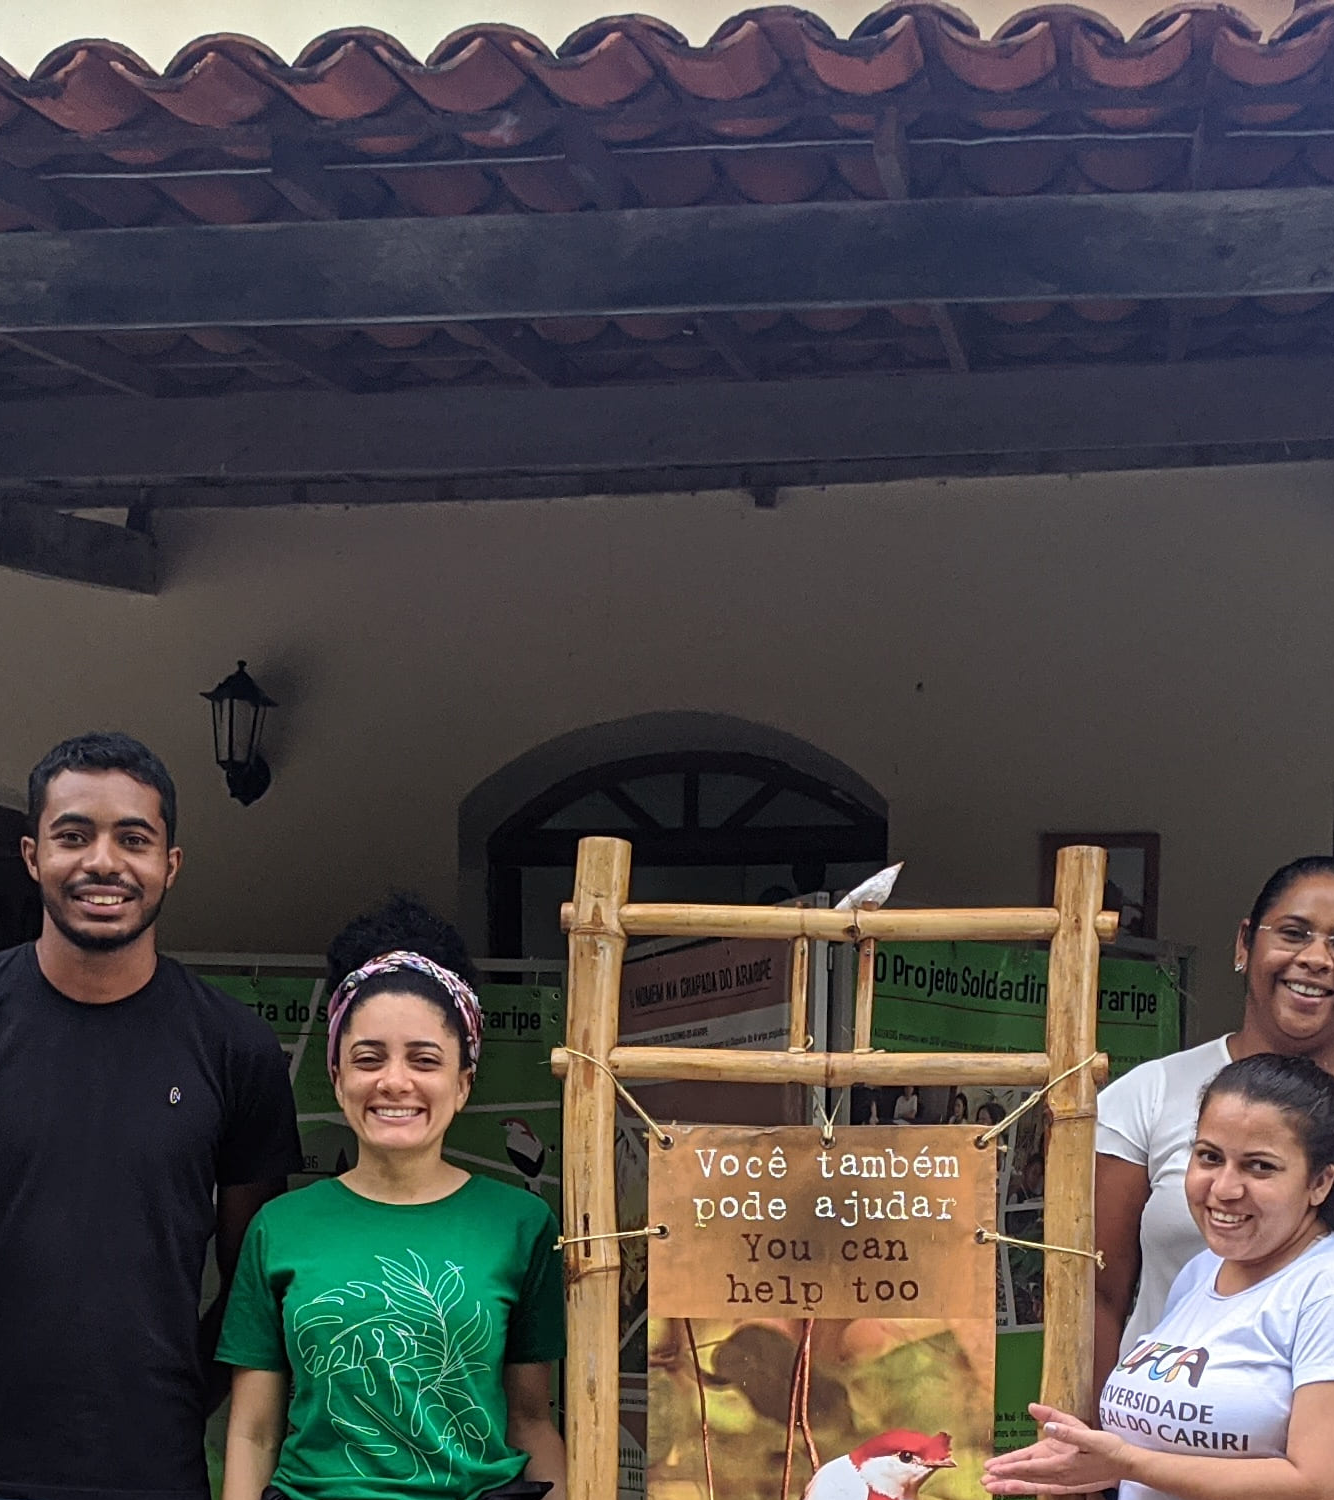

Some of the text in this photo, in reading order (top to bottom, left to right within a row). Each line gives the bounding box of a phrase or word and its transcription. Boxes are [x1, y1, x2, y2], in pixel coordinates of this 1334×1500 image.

[680, 970, 718, 999] CHAPADA
[719, 968, 733, 989] DO
[874, 952, 1157, 1020] O Projeto Soldadin raripe
[285, 1000, 310, 1022] do
[315, 1006, 328, 1022] s
[481, 1006, 541, 1035] raripe
[695, 1146, 960, 1178] Você também
[693, 1190, 957, 1228] pode ajudar
[742, 1233, 909, 1263] You can
[726, 1273, 919, 1311] help too
[1102, 1385, 1214, 1424] IVERSIDADE
[1100, 1407, 1249, 1451] RAL DO CARIRI
